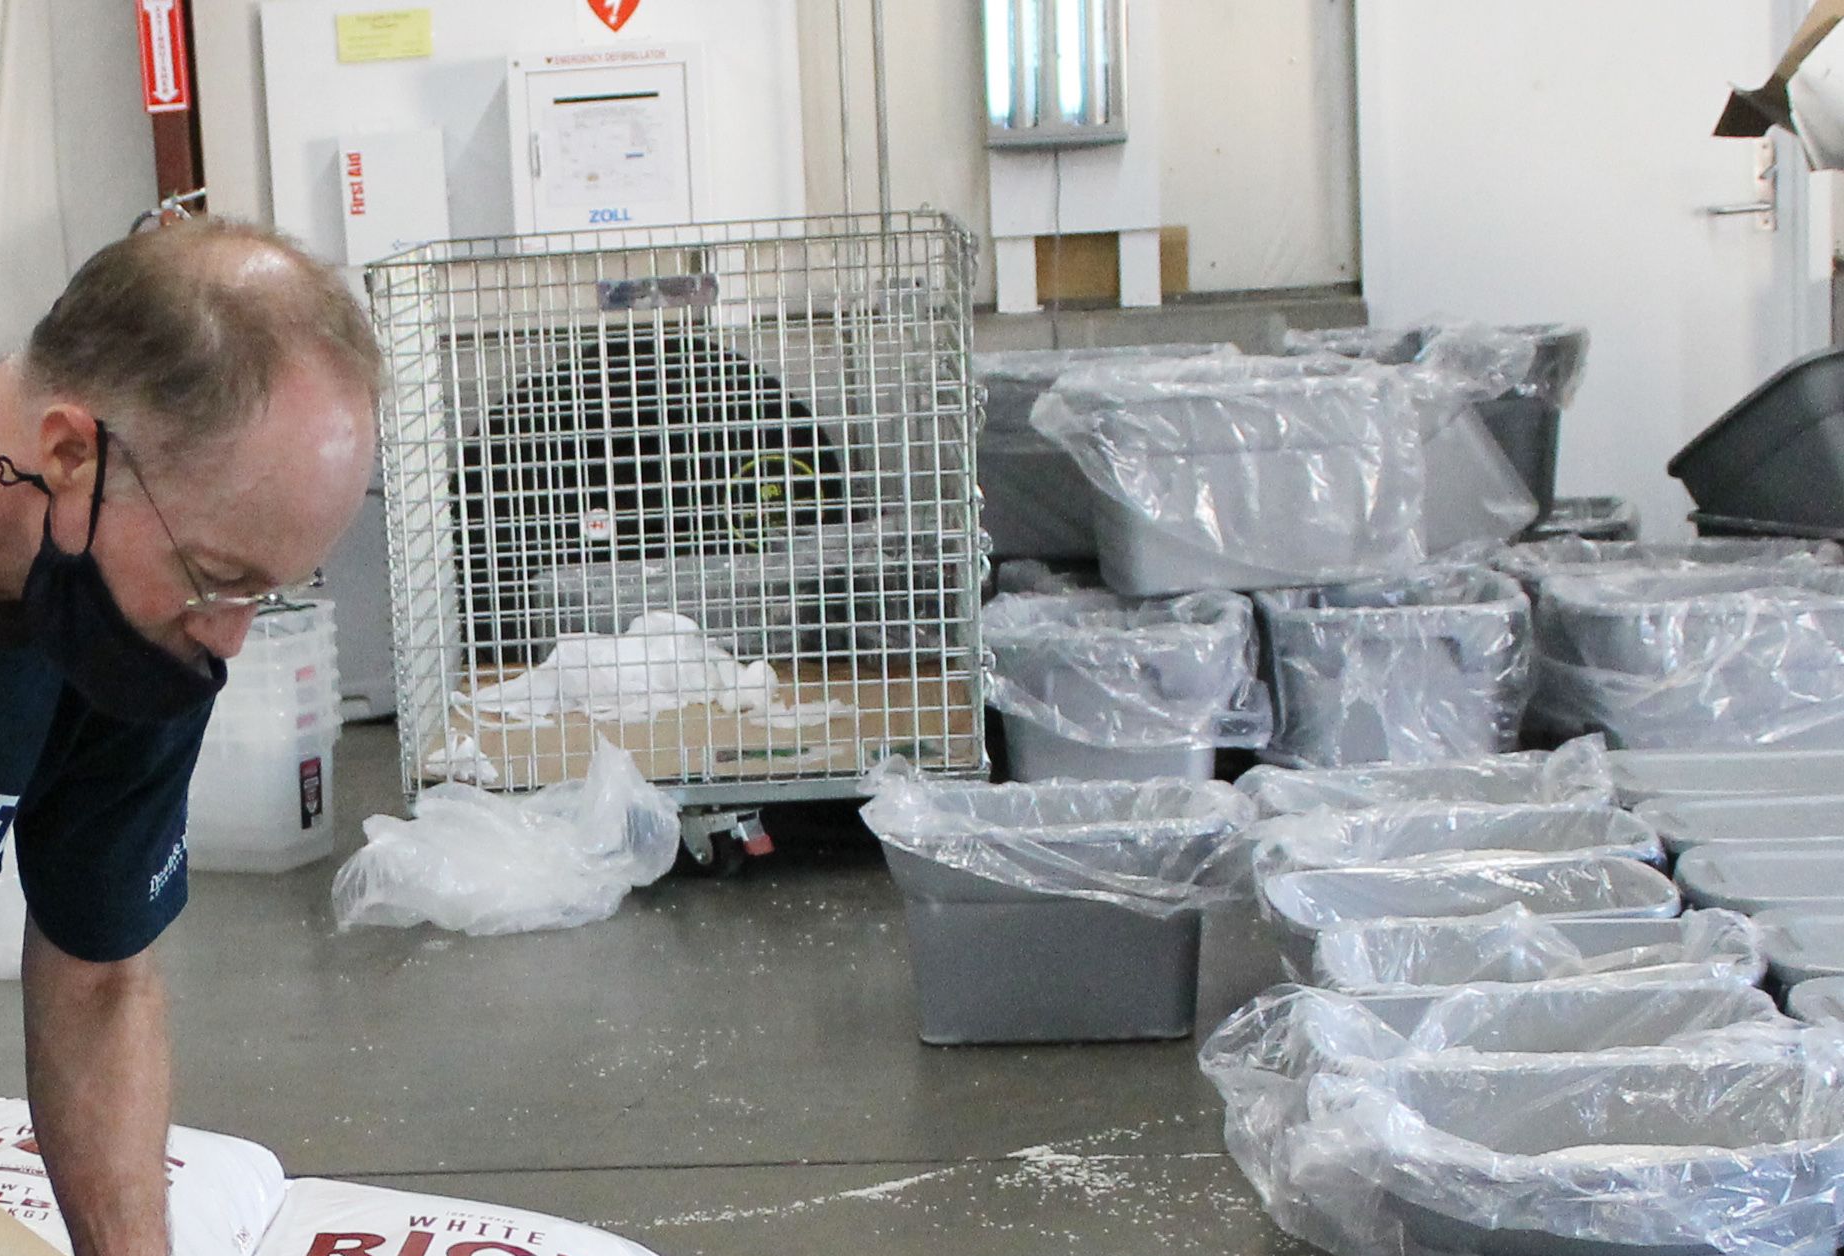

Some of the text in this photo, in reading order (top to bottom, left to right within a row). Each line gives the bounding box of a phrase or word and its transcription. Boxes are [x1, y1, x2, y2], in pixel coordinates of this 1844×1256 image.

[347, 152, 366, 215] First Aid
[588, 207, 632, 224] ZOLL
[408, 1214, 547, 1246] WHITE
